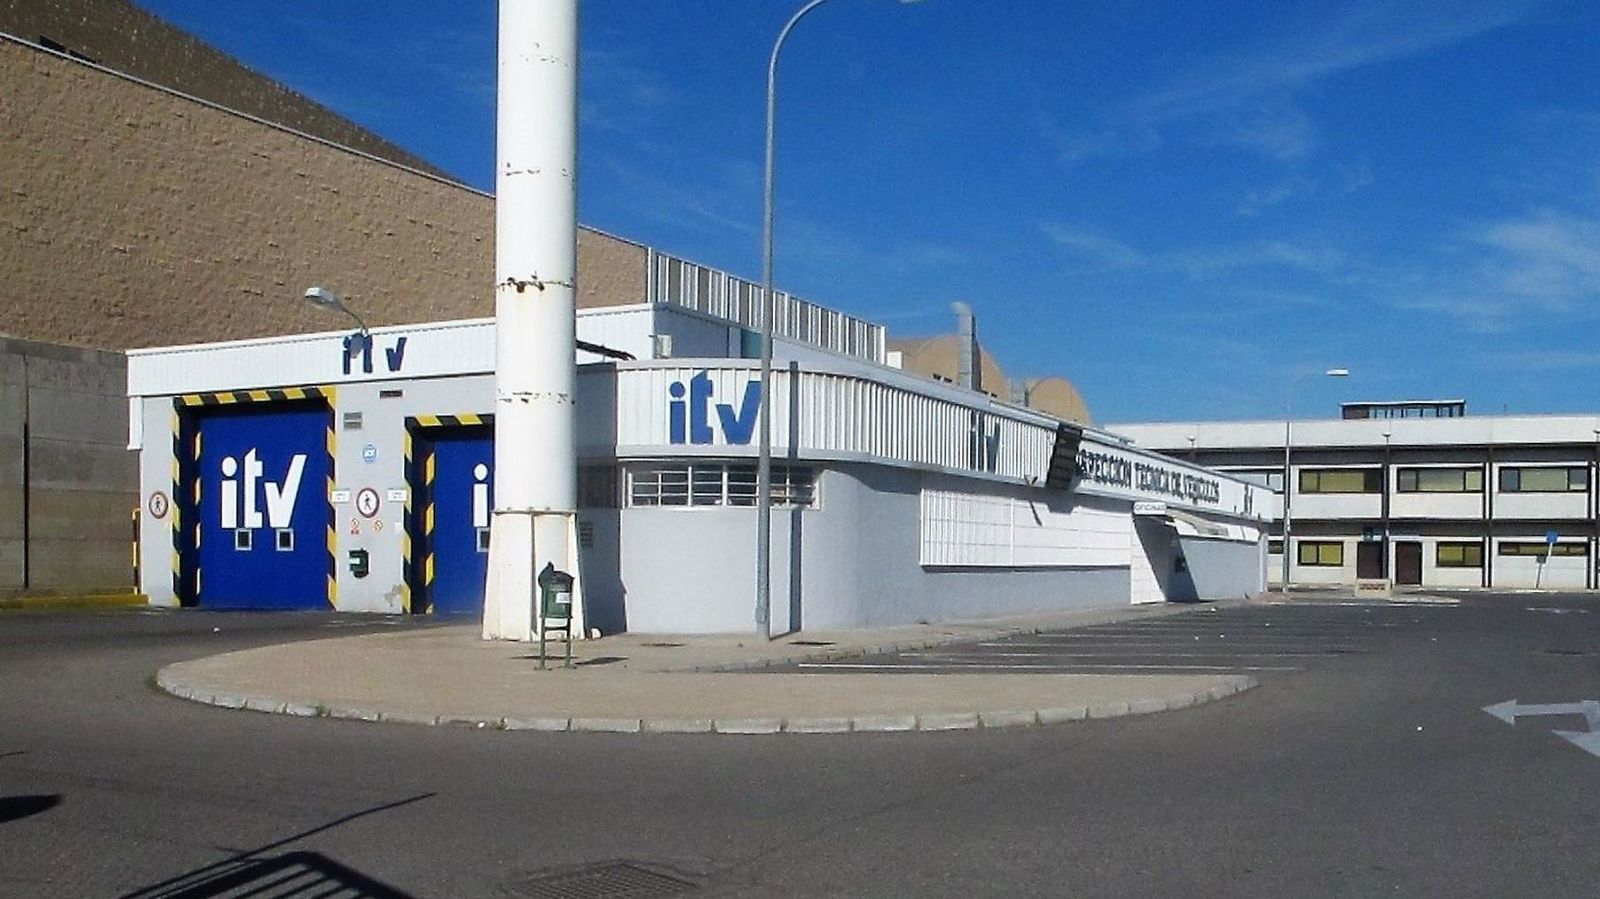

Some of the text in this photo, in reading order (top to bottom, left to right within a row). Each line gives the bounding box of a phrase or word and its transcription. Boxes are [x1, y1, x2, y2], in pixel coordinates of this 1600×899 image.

[343, 333, 407, 375] itv
[668, 368, 762, 445] itv
[221, 447, 308, 529] itv
